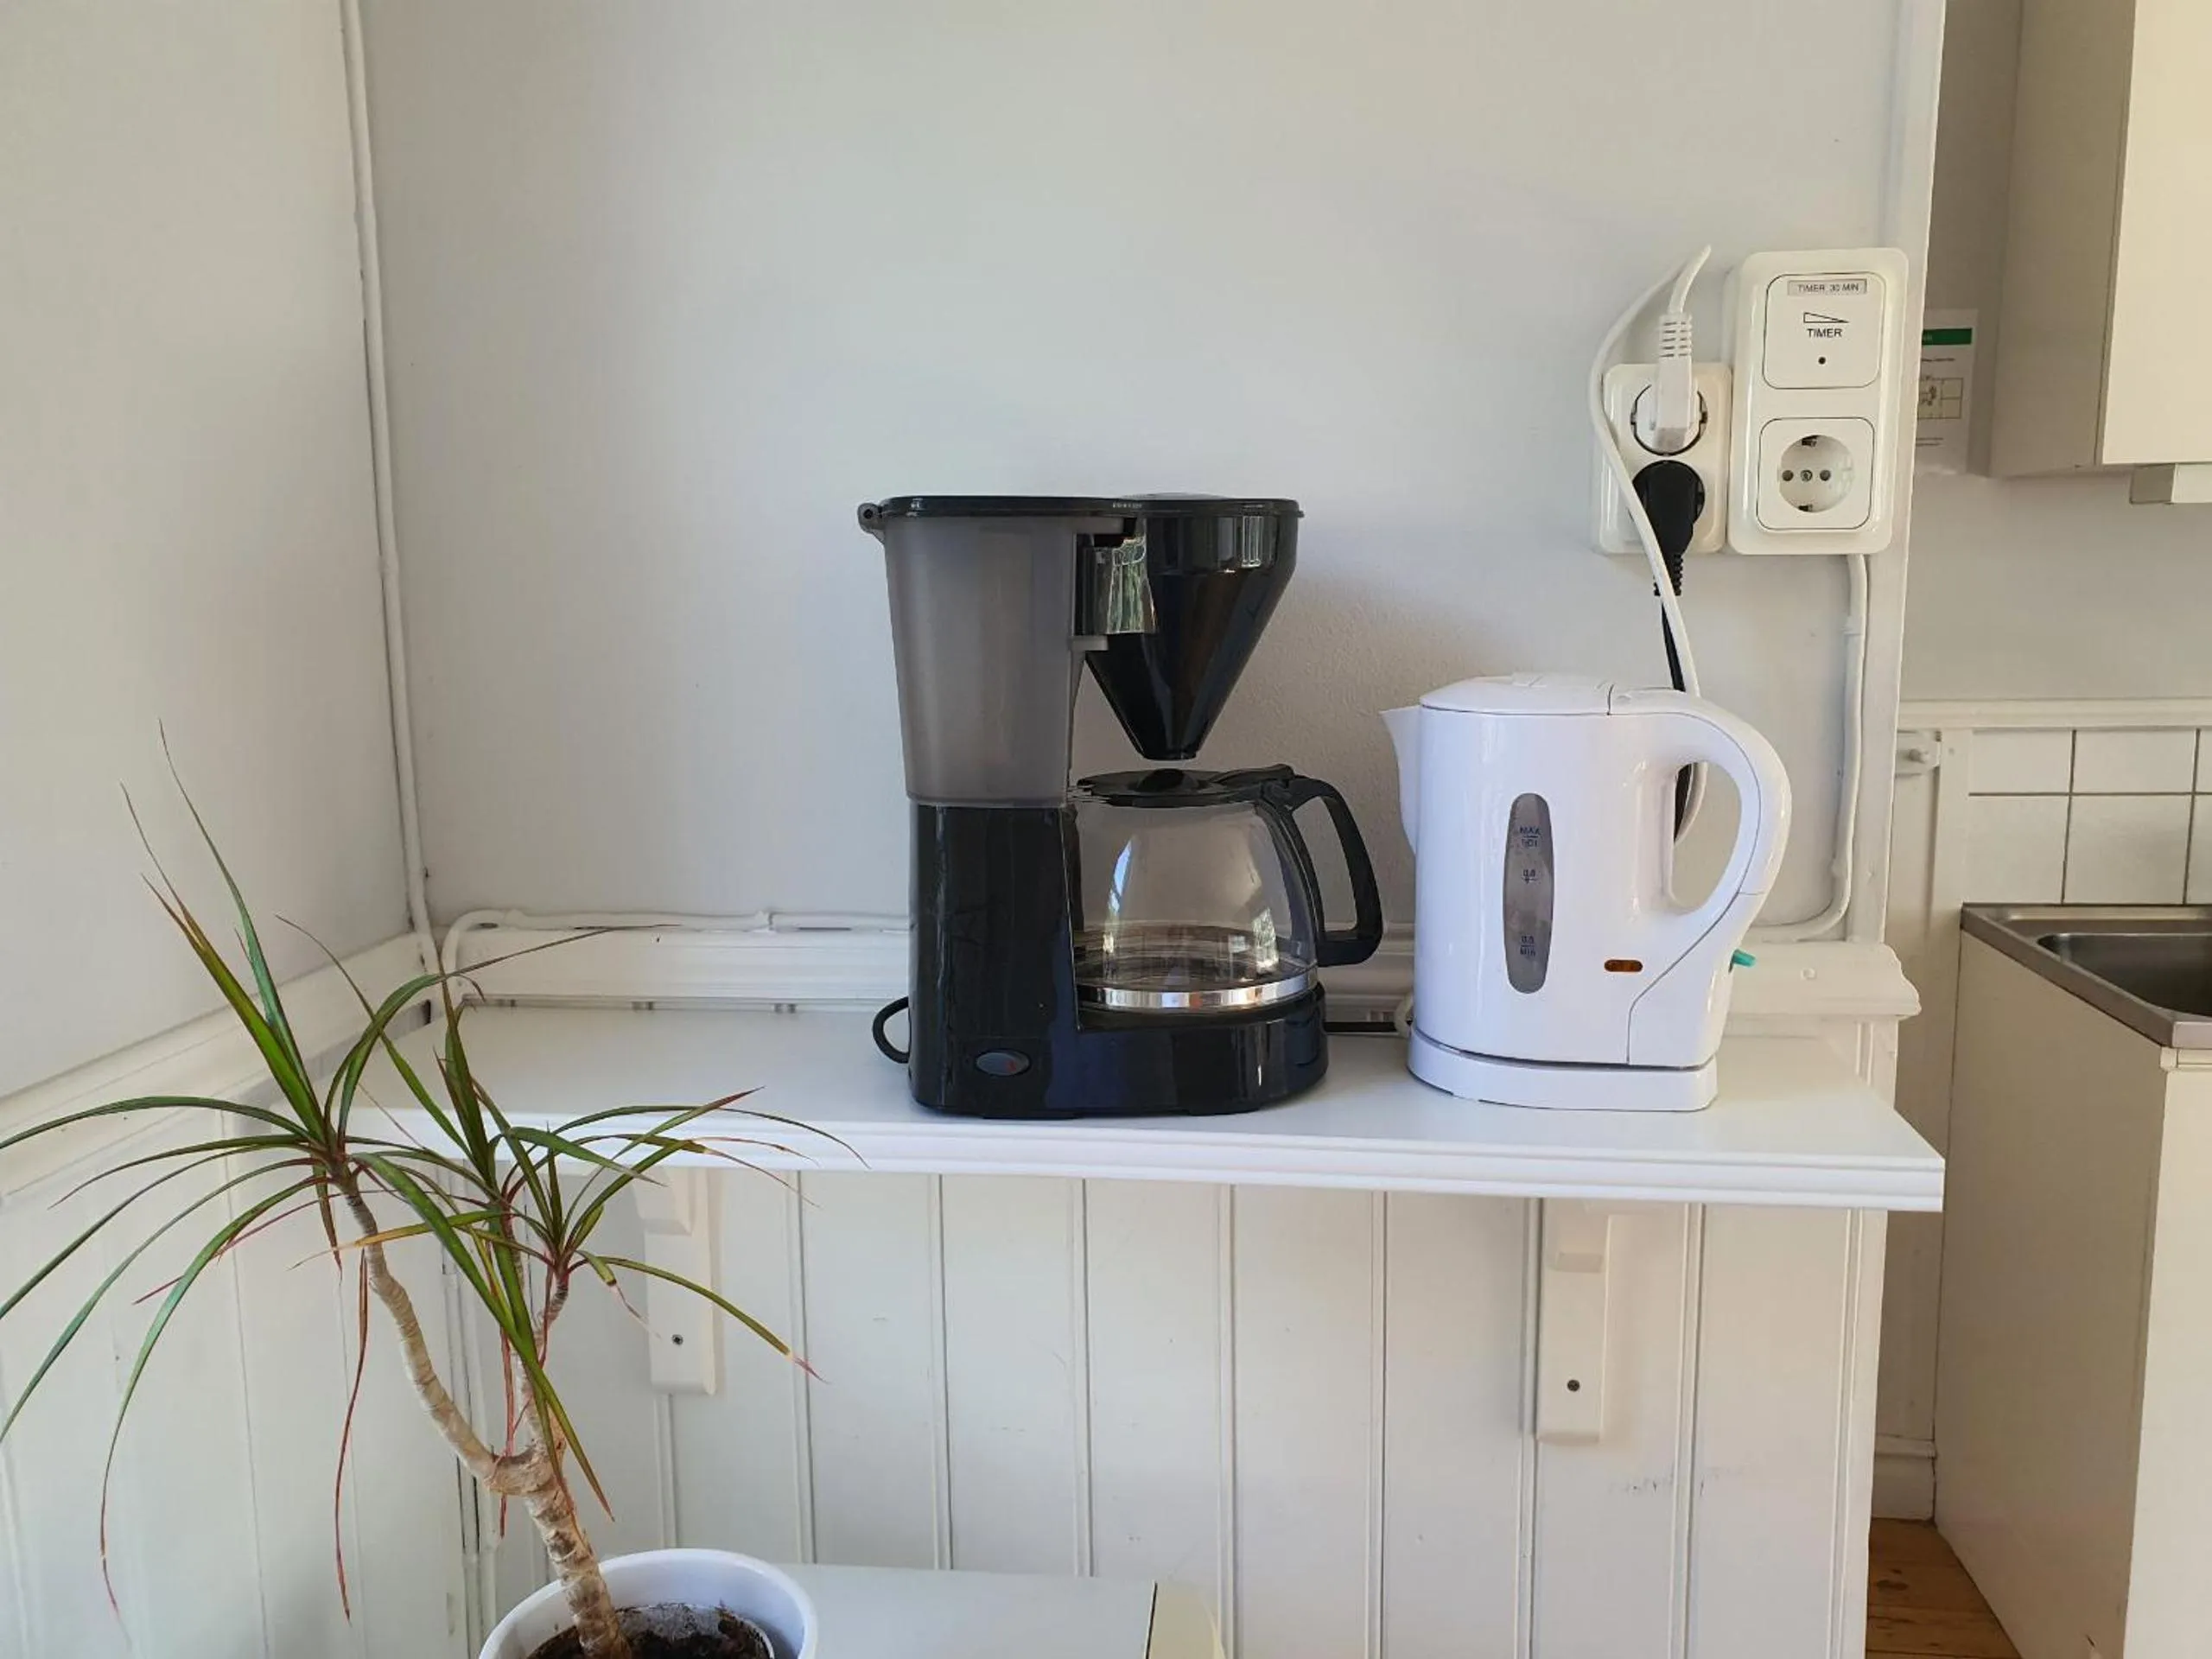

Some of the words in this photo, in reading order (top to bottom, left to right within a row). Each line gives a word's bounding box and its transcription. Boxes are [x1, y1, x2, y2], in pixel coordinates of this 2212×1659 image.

[1798, 283, 1825, 292] TIMER
[1842, 283, 1859, 291] MIN
[1807, 328, 1843, 338] TIMER
